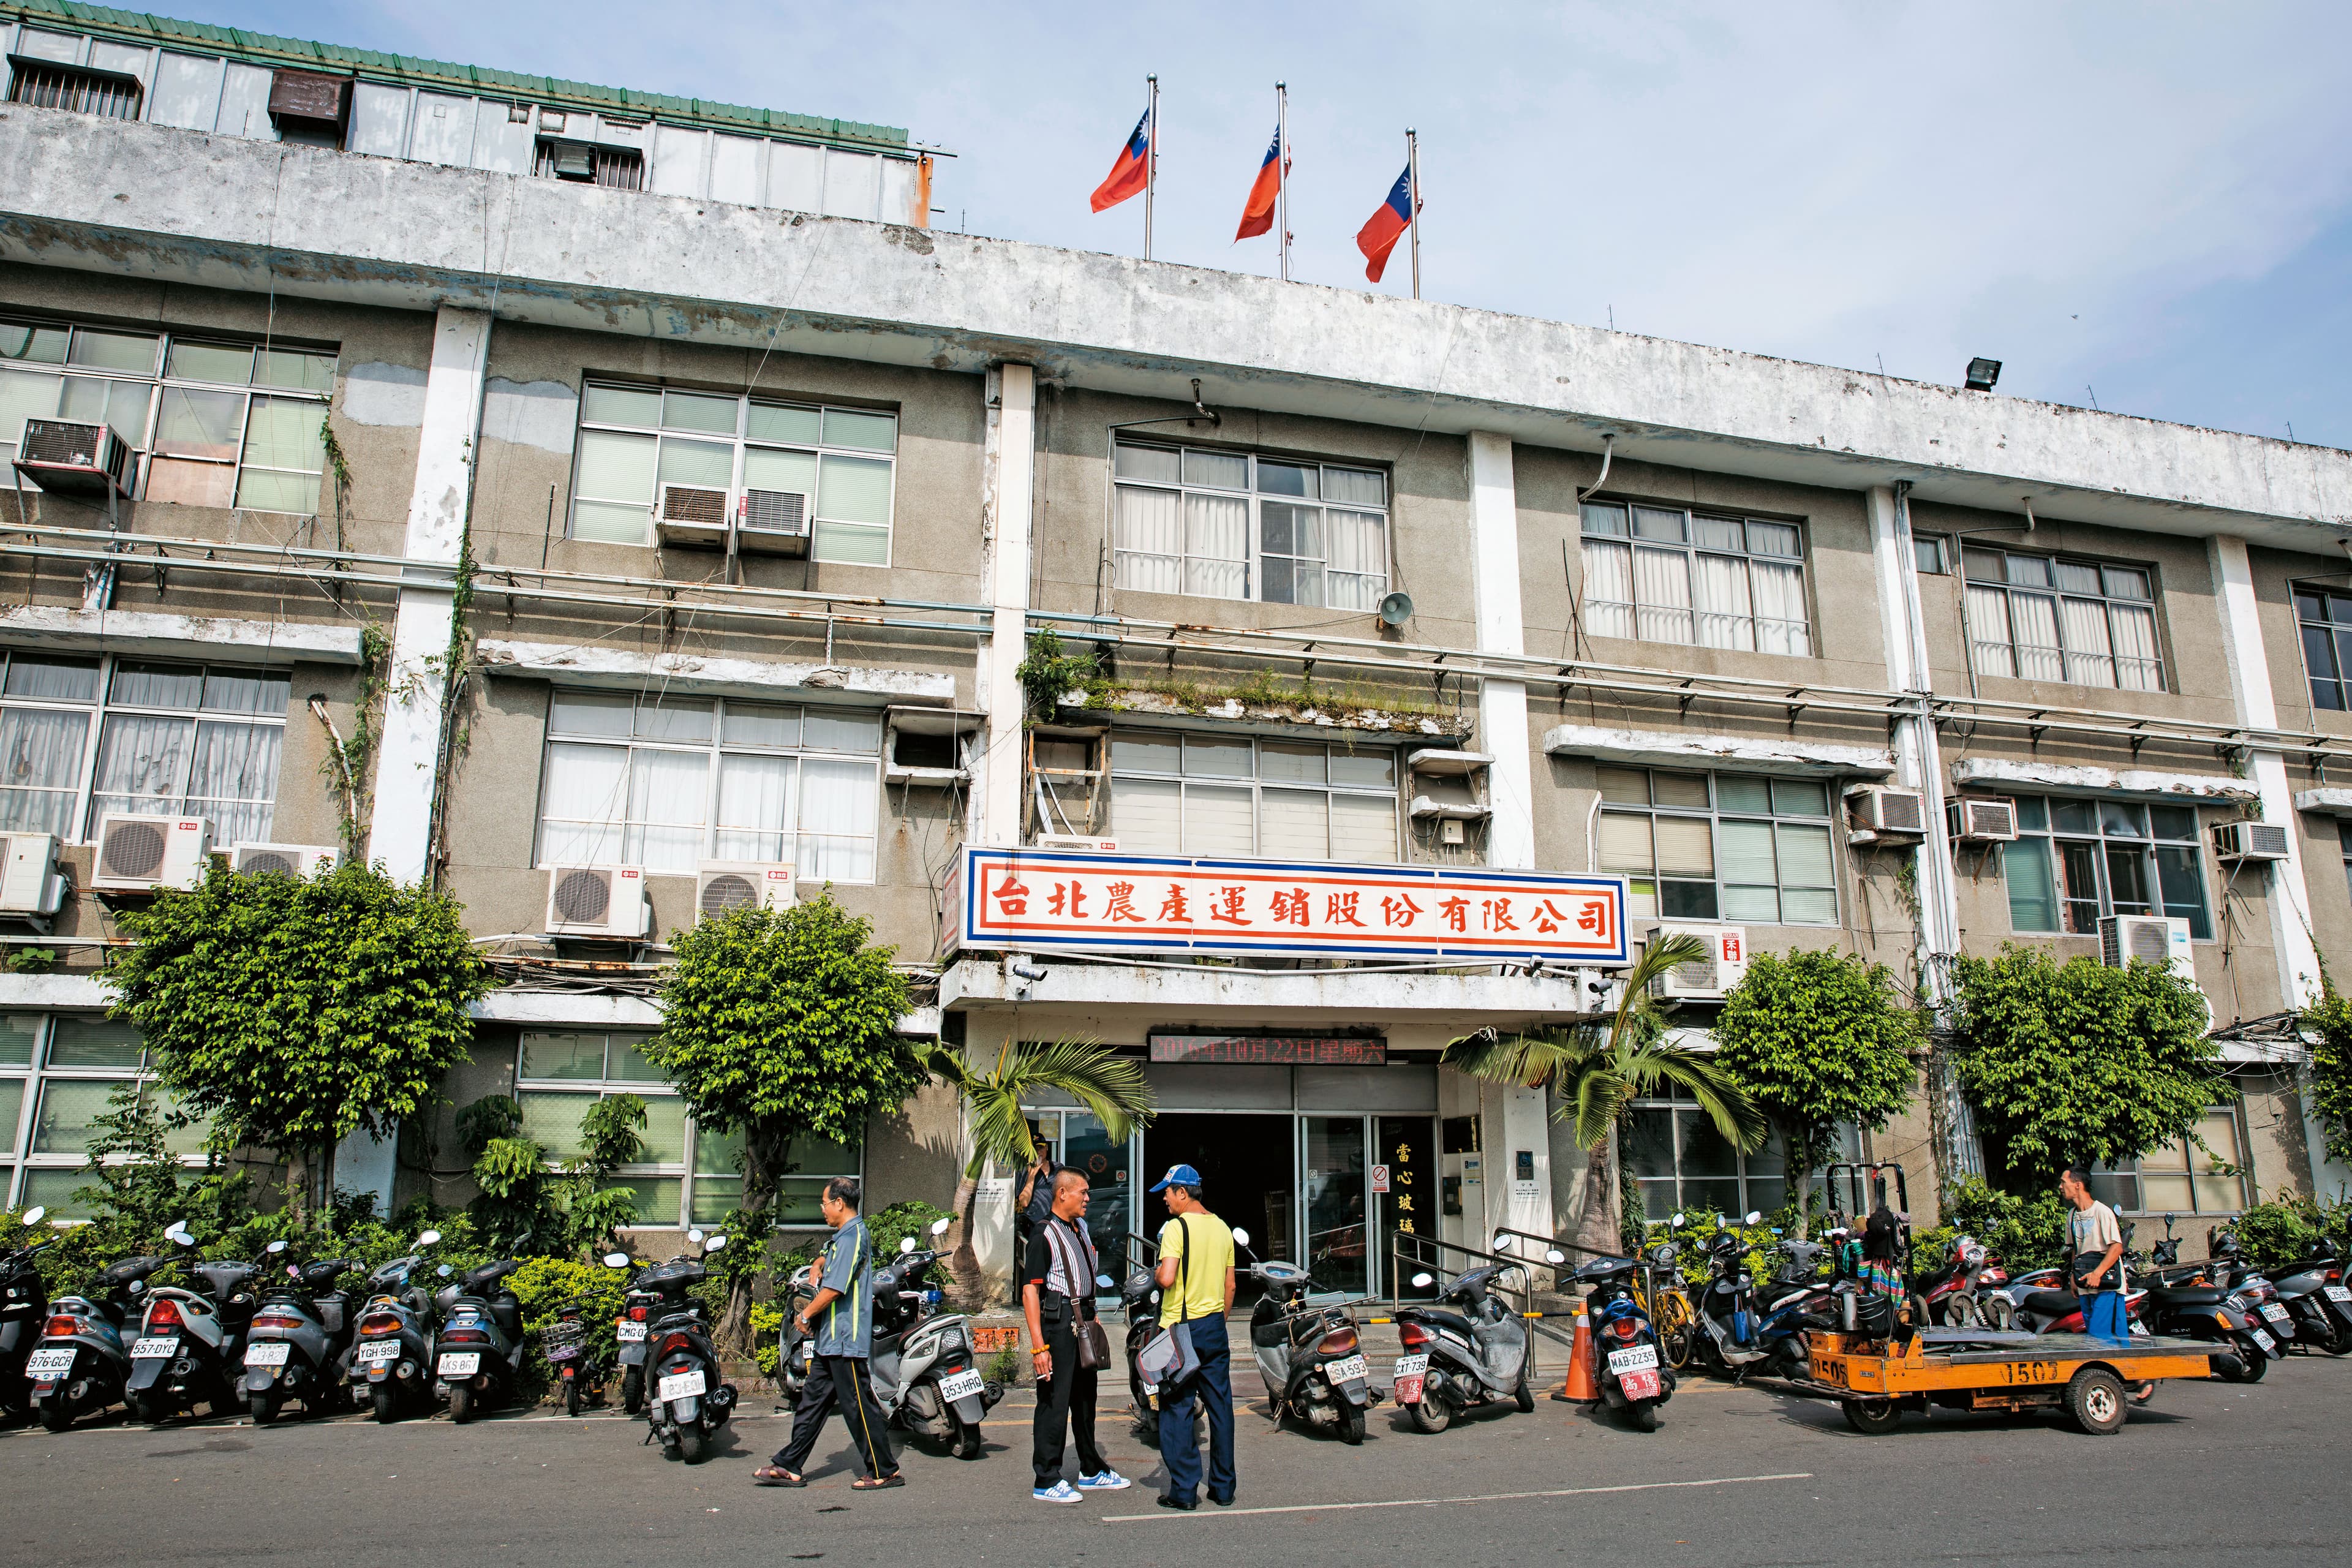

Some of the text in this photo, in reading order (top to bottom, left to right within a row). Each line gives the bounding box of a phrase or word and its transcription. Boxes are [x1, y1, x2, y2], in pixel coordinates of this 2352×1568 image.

[992, 877, 1605, 937] 台北農產運銷股份有限公司
[1396, 1143, 1415, 1234] 當心玻璃
[133, 1344, 175, 1354] 557-DYC
[360, 1346, 399, 1359] YGH-998
[29, 1356, 73, 1368] 976-GCR
[1395, 1360, 1426, 1374] CXT-739
[1610, 1351, 1655, 1370] MAB-2235
